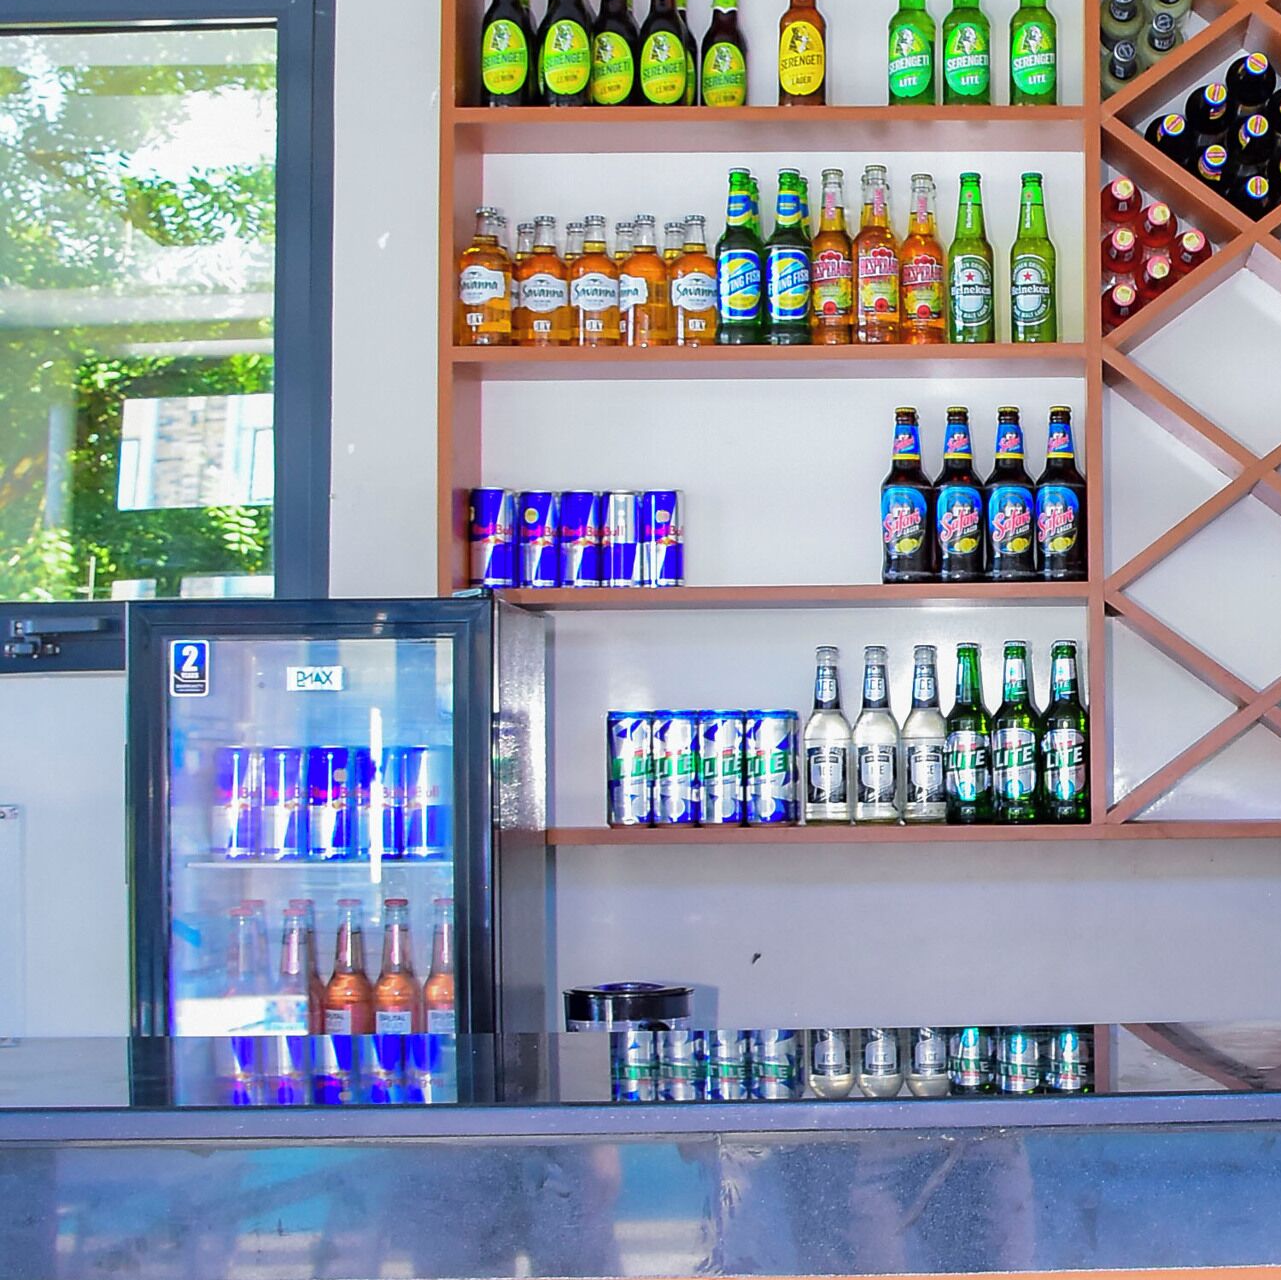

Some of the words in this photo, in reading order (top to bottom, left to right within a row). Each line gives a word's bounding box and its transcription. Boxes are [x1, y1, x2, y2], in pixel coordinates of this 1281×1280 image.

[780, 53, 823, 71] SERENGETI
[898, 76, 917, 87] LITE
[961, 75, 980, 86] LITE
[1028, 73, 1046, 85] LITE
[522, 284, 564, 298] Savanna
[574, 283, 616, 298] Savanna
[951, 286, 992, 296] Heineken
[1011, 285, 1050, 295] Heineken
[884, 507, 921, 542] Safari
[940, 508, 979, 541] Safari
[992, 507, 1031, 541] Safari
[1037, 506, 1074, 542] Safari
[181, 645, 199, 671] 2
[948, 749, 986, 770] LITE
[995, 745, 1033, 768] LITE
[1046, 745, 1083, 769] LITE
